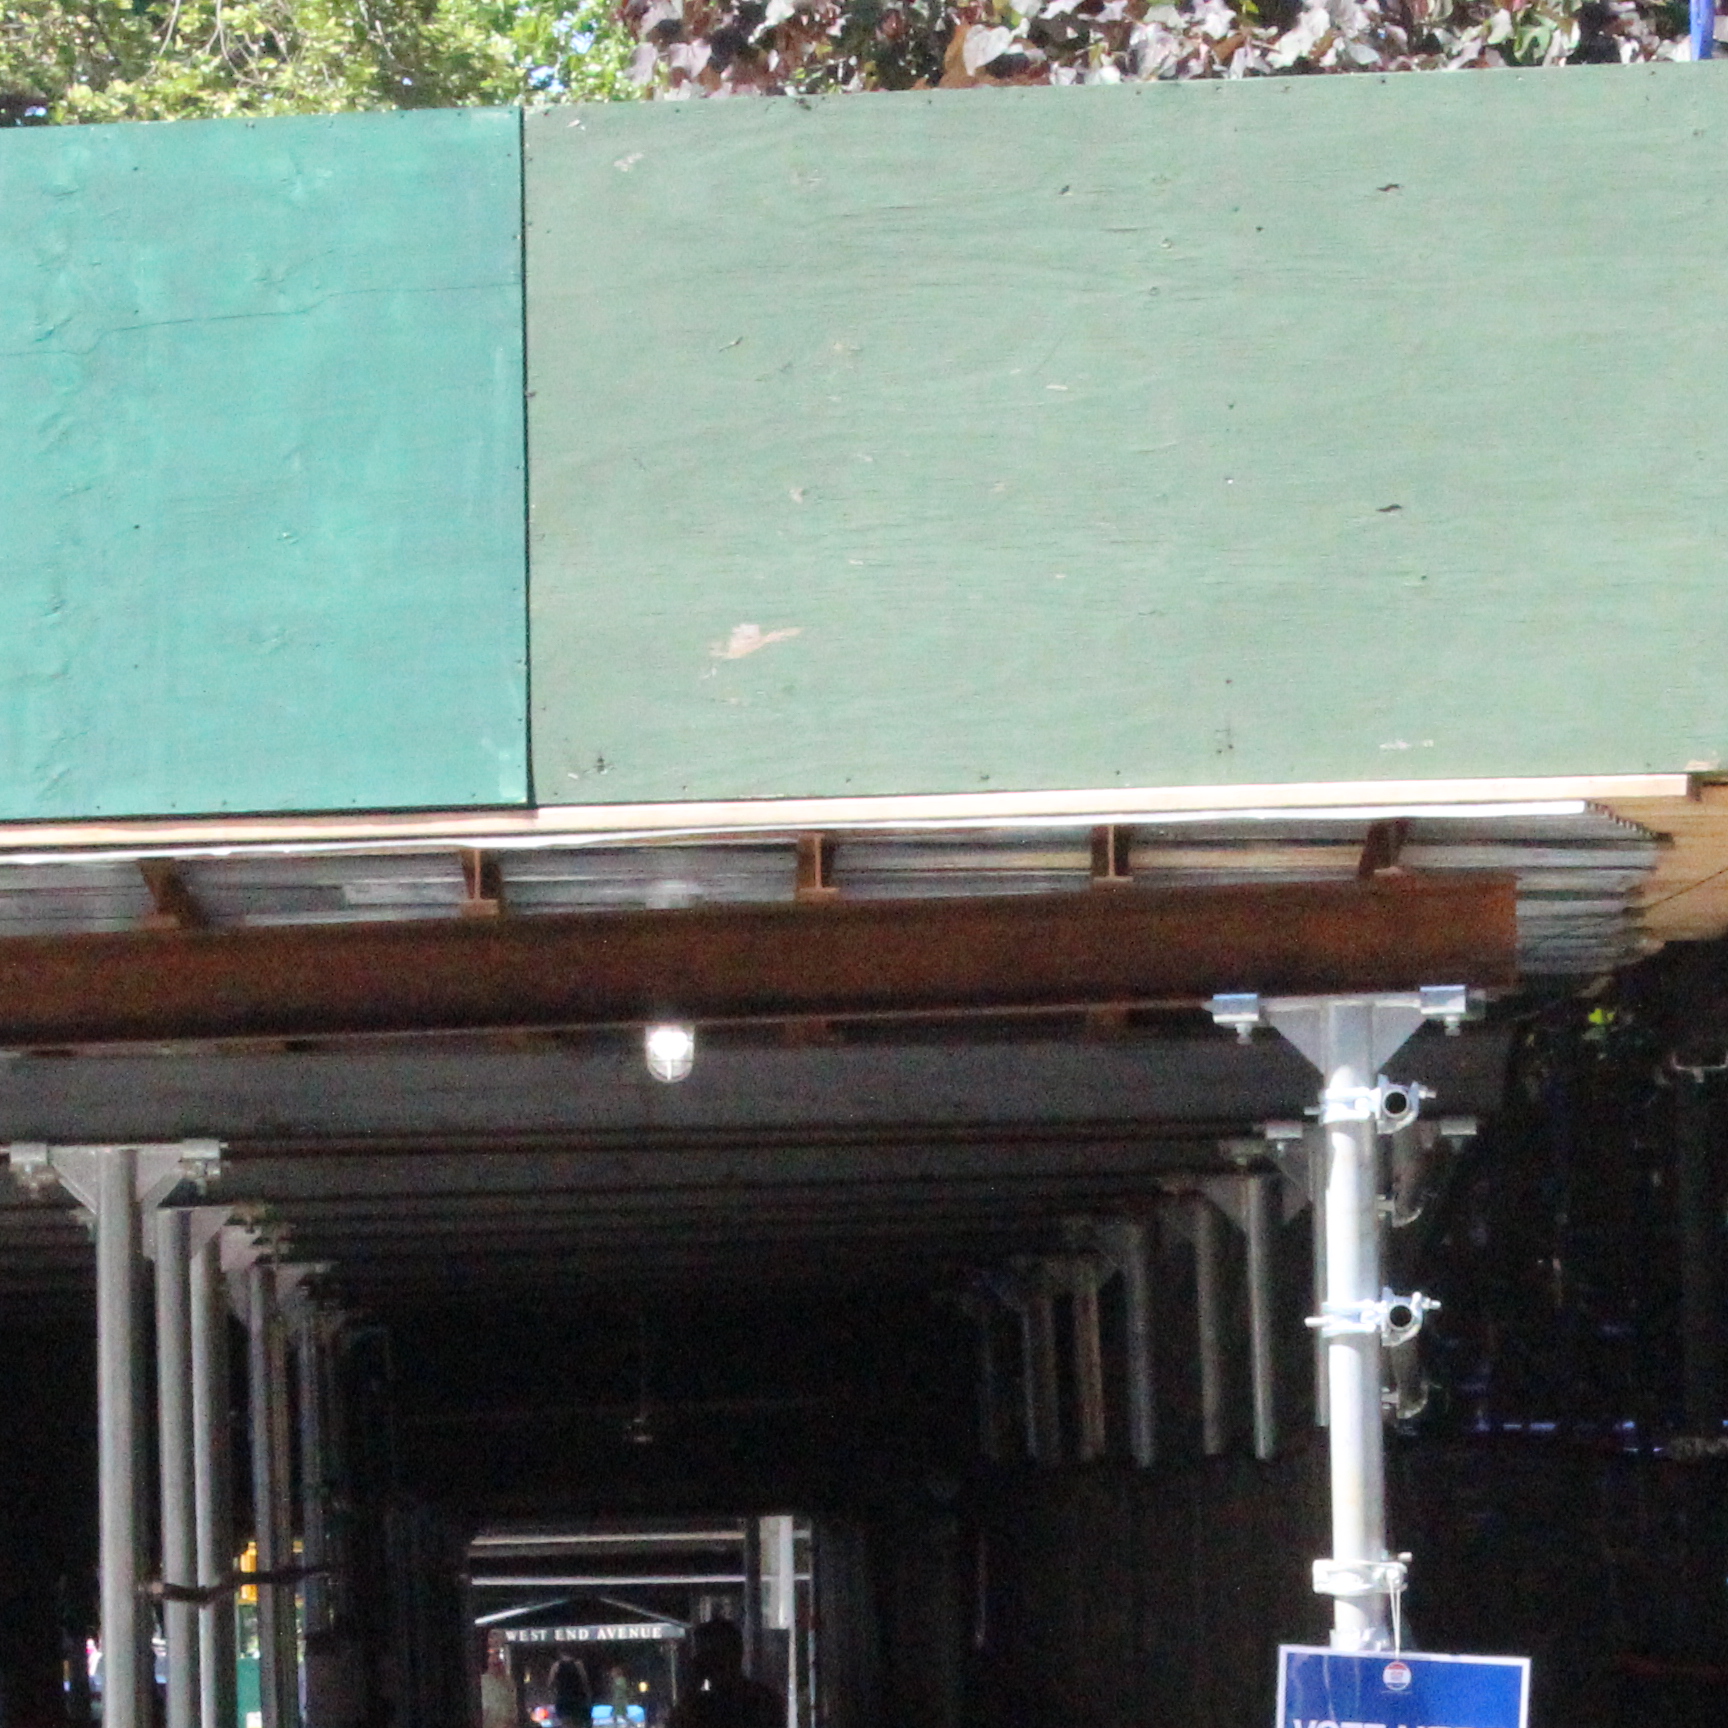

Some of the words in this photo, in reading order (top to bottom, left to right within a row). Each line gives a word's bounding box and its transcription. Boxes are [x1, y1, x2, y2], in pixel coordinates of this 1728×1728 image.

[505, 1629, 547, 1642] WEST
[554, 1628, 590, 1641] END
[596, 1626, 663, 1640] AVENUE
